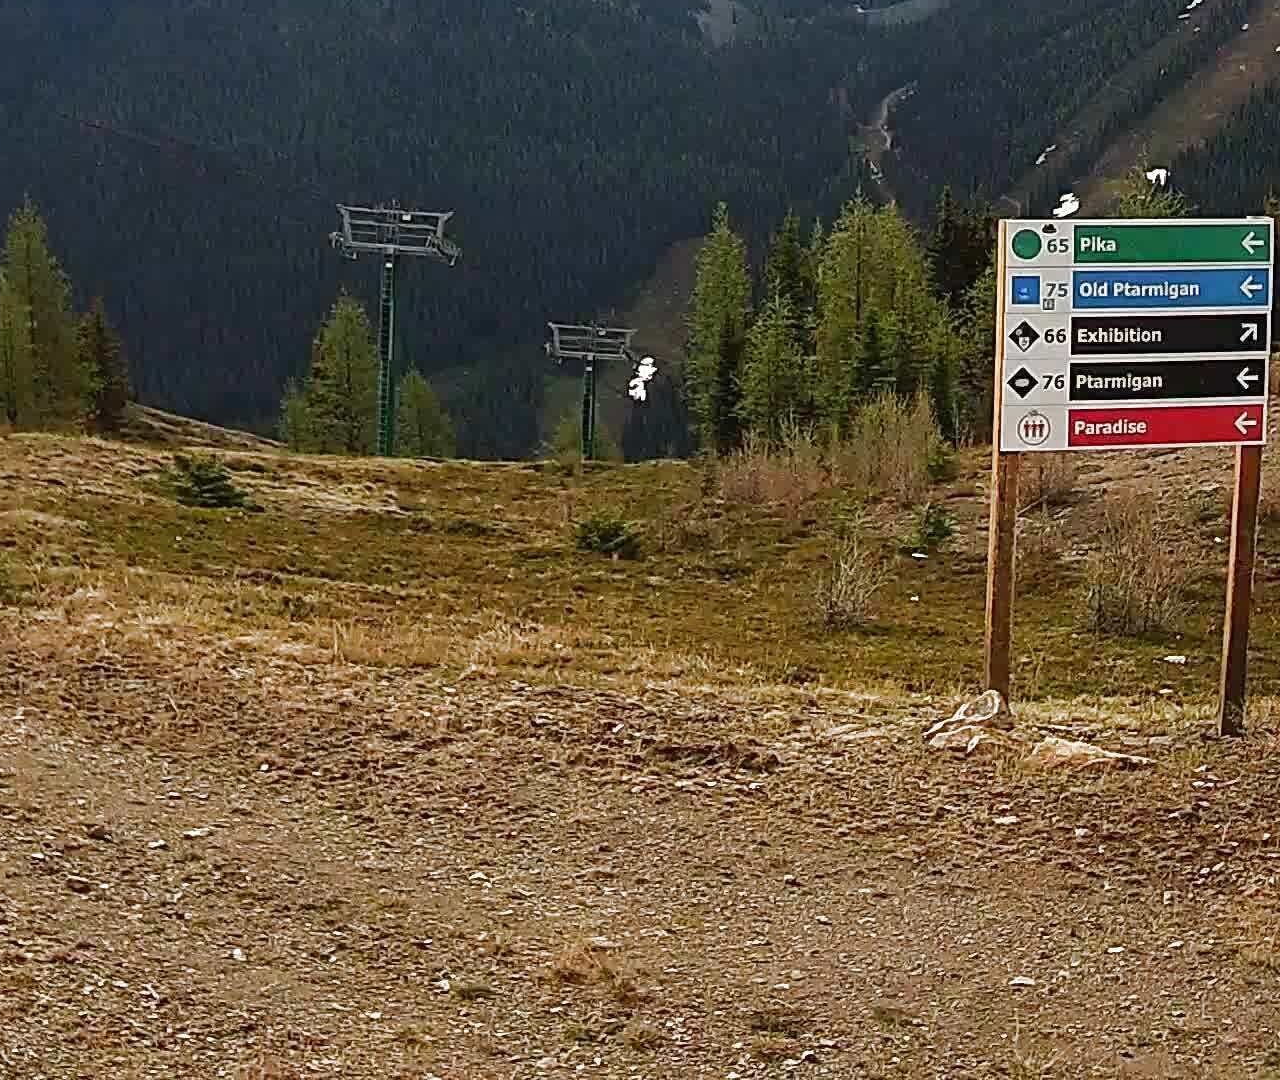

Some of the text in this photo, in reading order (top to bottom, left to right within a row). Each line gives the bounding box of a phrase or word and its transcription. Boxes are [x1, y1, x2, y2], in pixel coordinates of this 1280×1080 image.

[1046, 235, 1116, 253] 65 Pika
[1045, 281, 1200, 299] 75 Old Ptarmigan
[1044, 327, 1162, 343] 66 Exhibition
[1042, 373, 1163, 392] 76 Ptarmigan
[1074, 419, 1147, 435] Paradise
